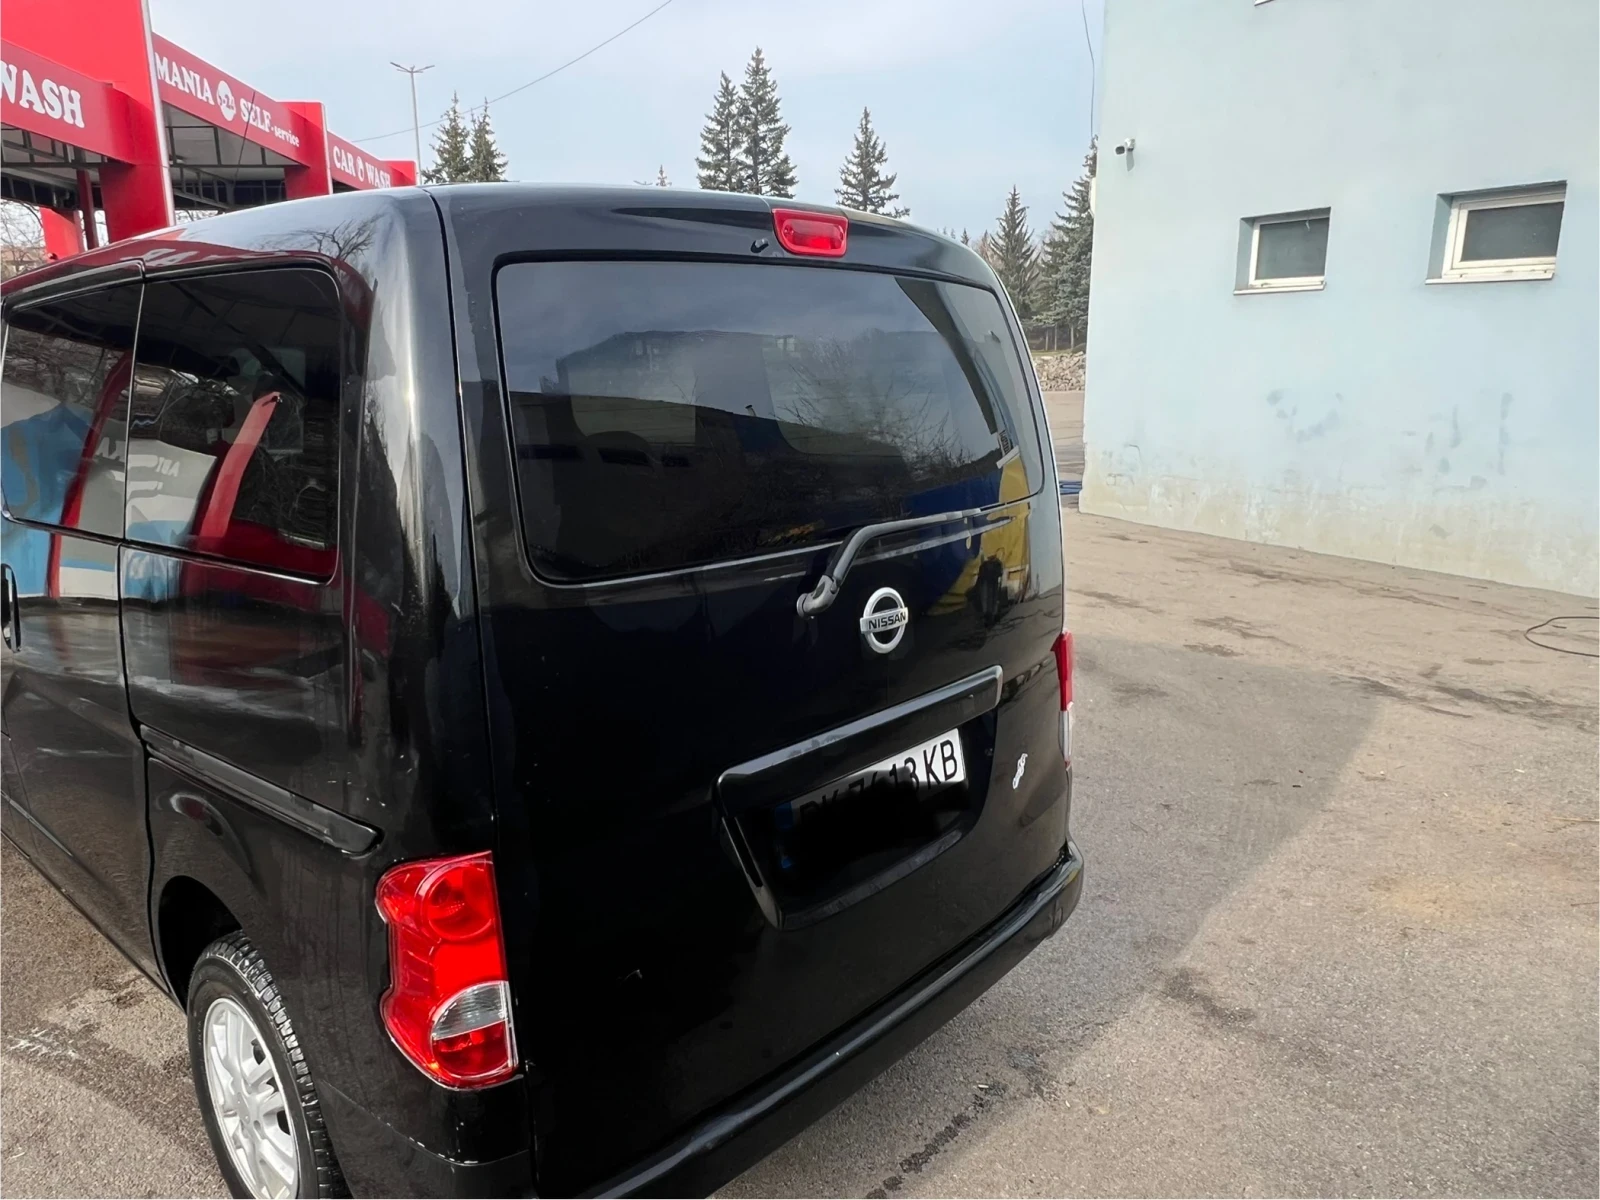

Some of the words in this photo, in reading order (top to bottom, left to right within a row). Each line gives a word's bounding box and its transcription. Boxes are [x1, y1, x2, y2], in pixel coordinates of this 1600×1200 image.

[155, 52, 215, 105] MANIA
[333, 145, 356, 177] CAR
[365, 161, 391, 188] WASH
[868, 611, 906, 630] NISSAN
[923, 739, 958, 790] KB
